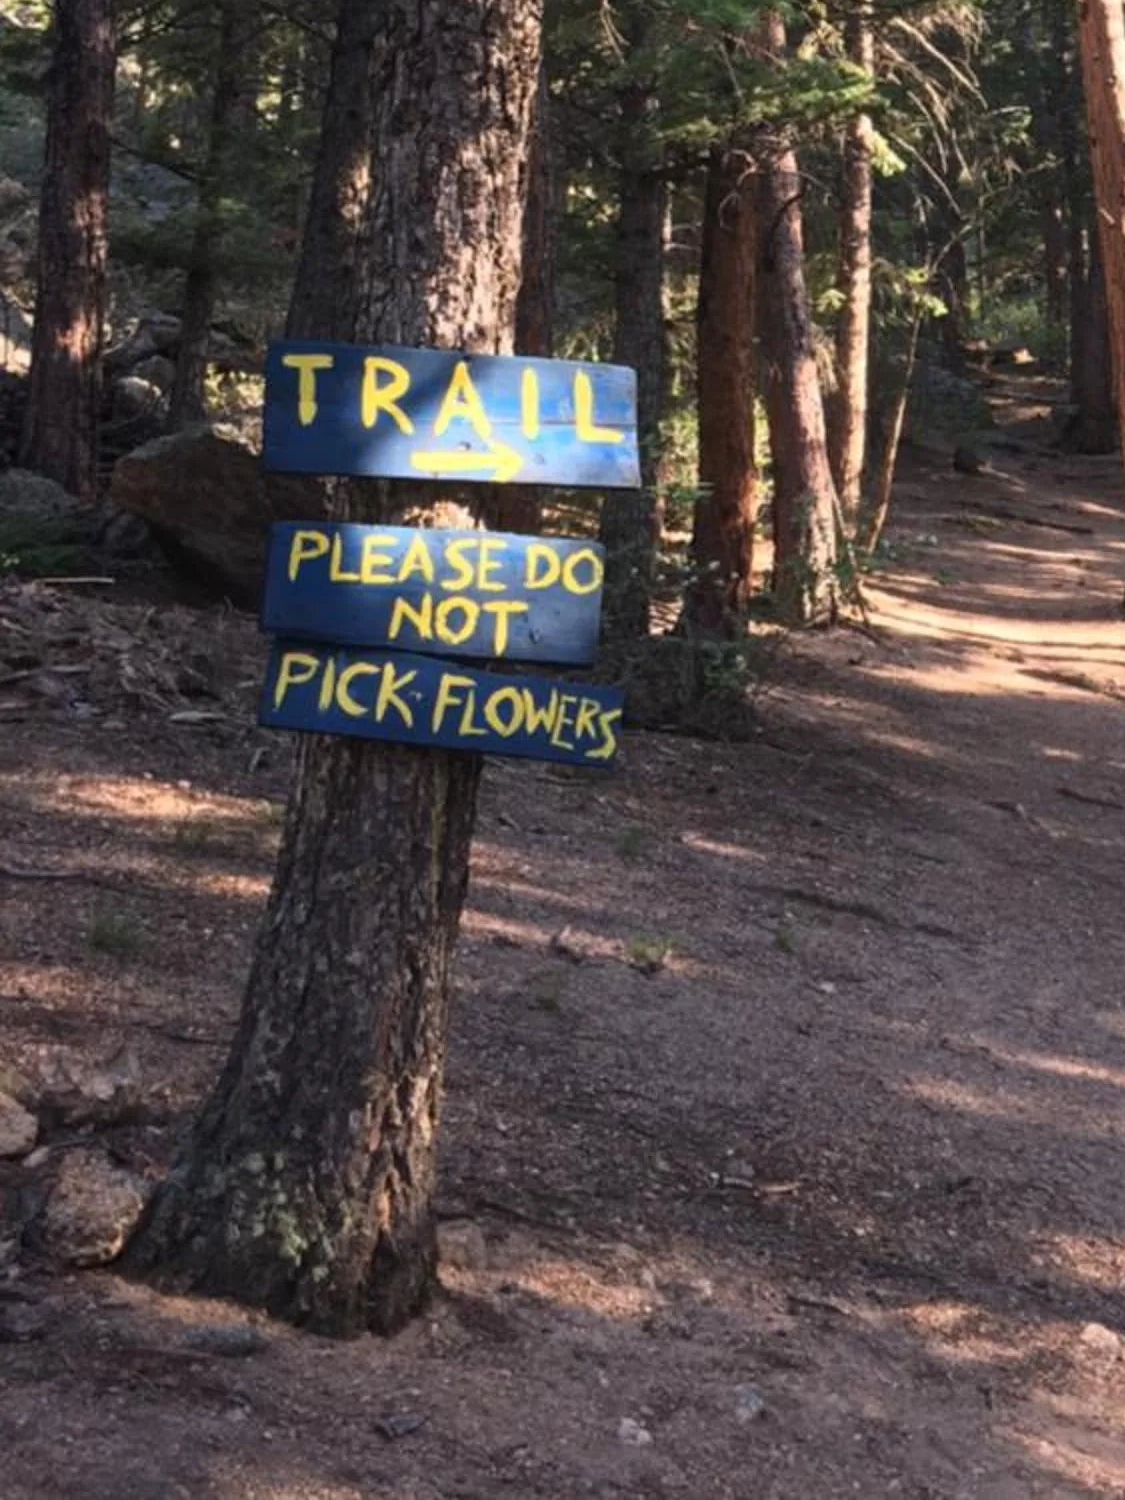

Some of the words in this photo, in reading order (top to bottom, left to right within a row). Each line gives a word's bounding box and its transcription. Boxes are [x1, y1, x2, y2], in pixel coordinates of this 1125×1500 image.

[282, 353, 624, 444] TRAIL
[288, 530, 507, 592] PLEASE
[523, 543, 605, 595] DO
[388, 593, 529, 656] NOT
[274, 652, 418, 728] PICK
[432, 673, 622, 760] FLOWERS
